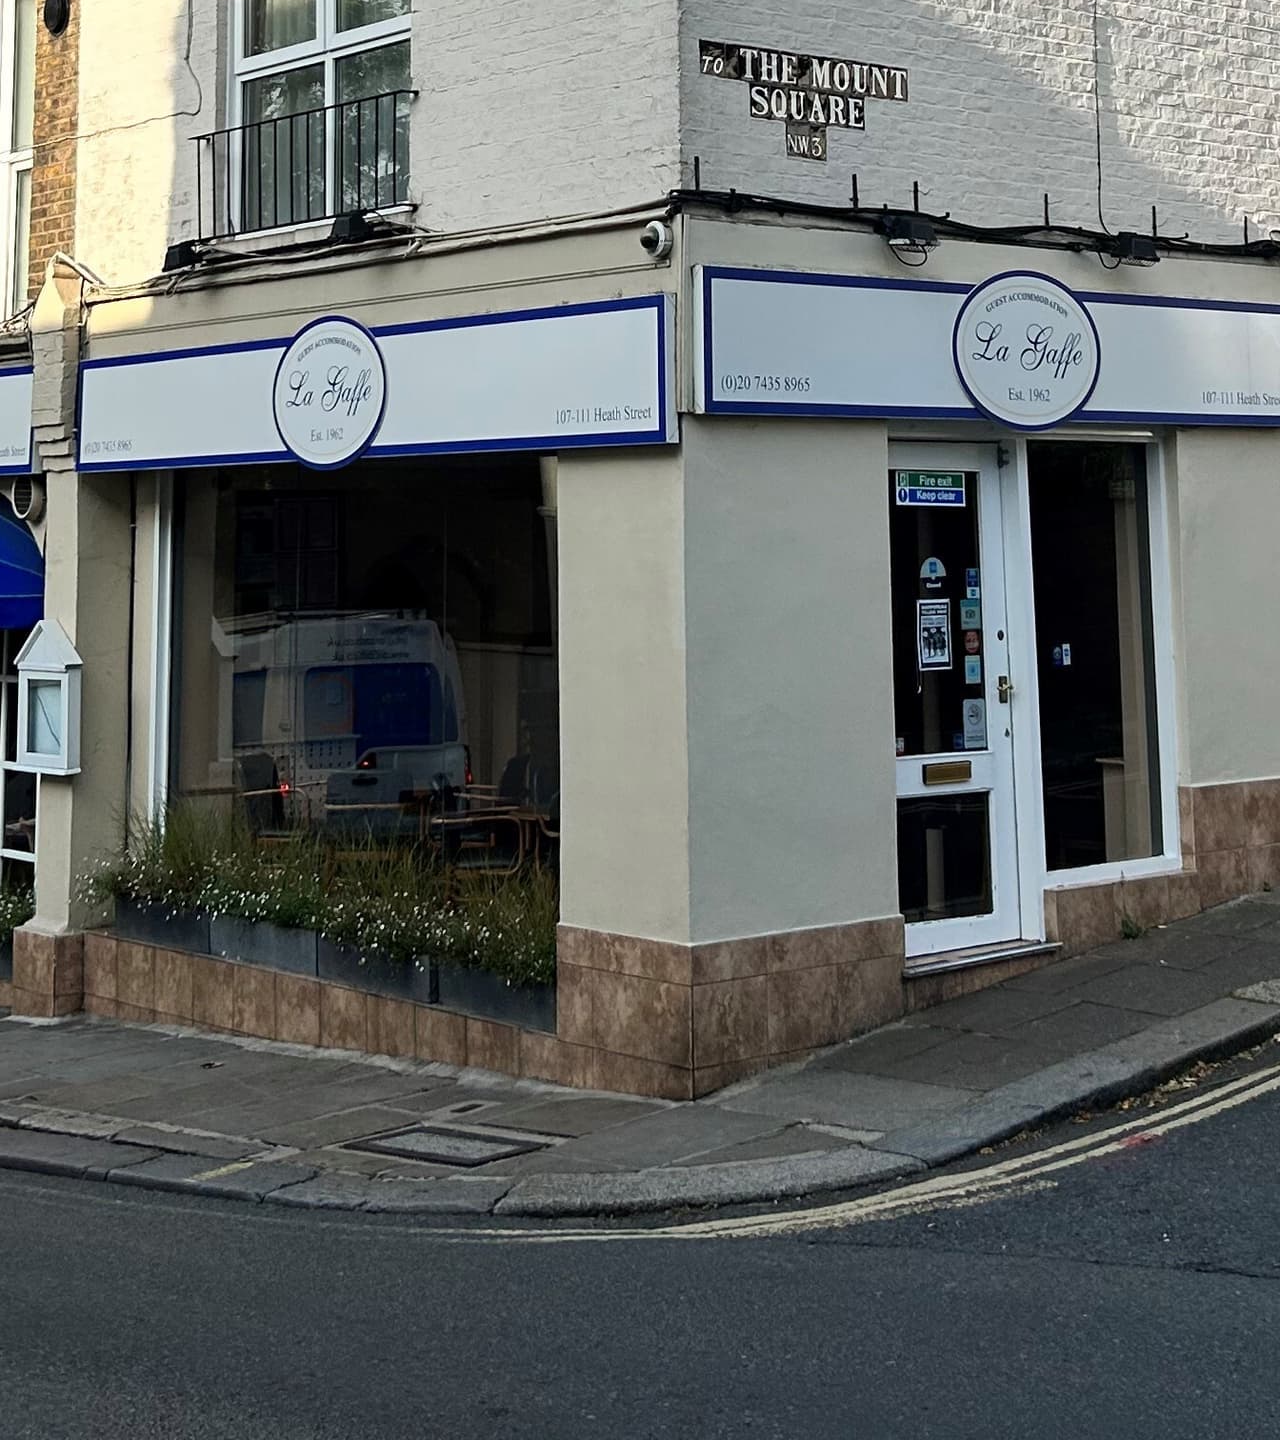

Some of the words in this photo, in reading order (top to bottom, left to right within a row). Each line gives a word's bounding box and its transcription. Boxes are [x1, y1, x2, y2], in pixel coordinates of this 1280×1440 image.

[739, 48, 797, 85] THE
[811, 58, 907, 99] MOUNT
[751, 86, 864, 128] SQUARE
[972, 321, 1011, 362] La
[1020, 323, 1083, 379] Gaffe
[285, 370, 314, 408] La
[321, 365, 371, 417] Gaffe
[721, 374, 751, 393] (0)20
[754, 375, 781, 391] 7435
[784, 376, 810, 392] 8965
[1008, 387, 1026, 402] Est.
[1029, 388, 1051, 402] 1962
[1202, 391, 1234, 405] 107-111
[1236, 392, 1261, 406] Heath
[556, 408, 590, 424] 107-111
[594, 406, 621, 422] Heath
[624, 405, 652, 421] Street
[919, 475, 936, 486] Fire
[937, 475, 953, 487] exit
[916, 490, 936, 501] Keep
[937, 491, 956, 500] clear
